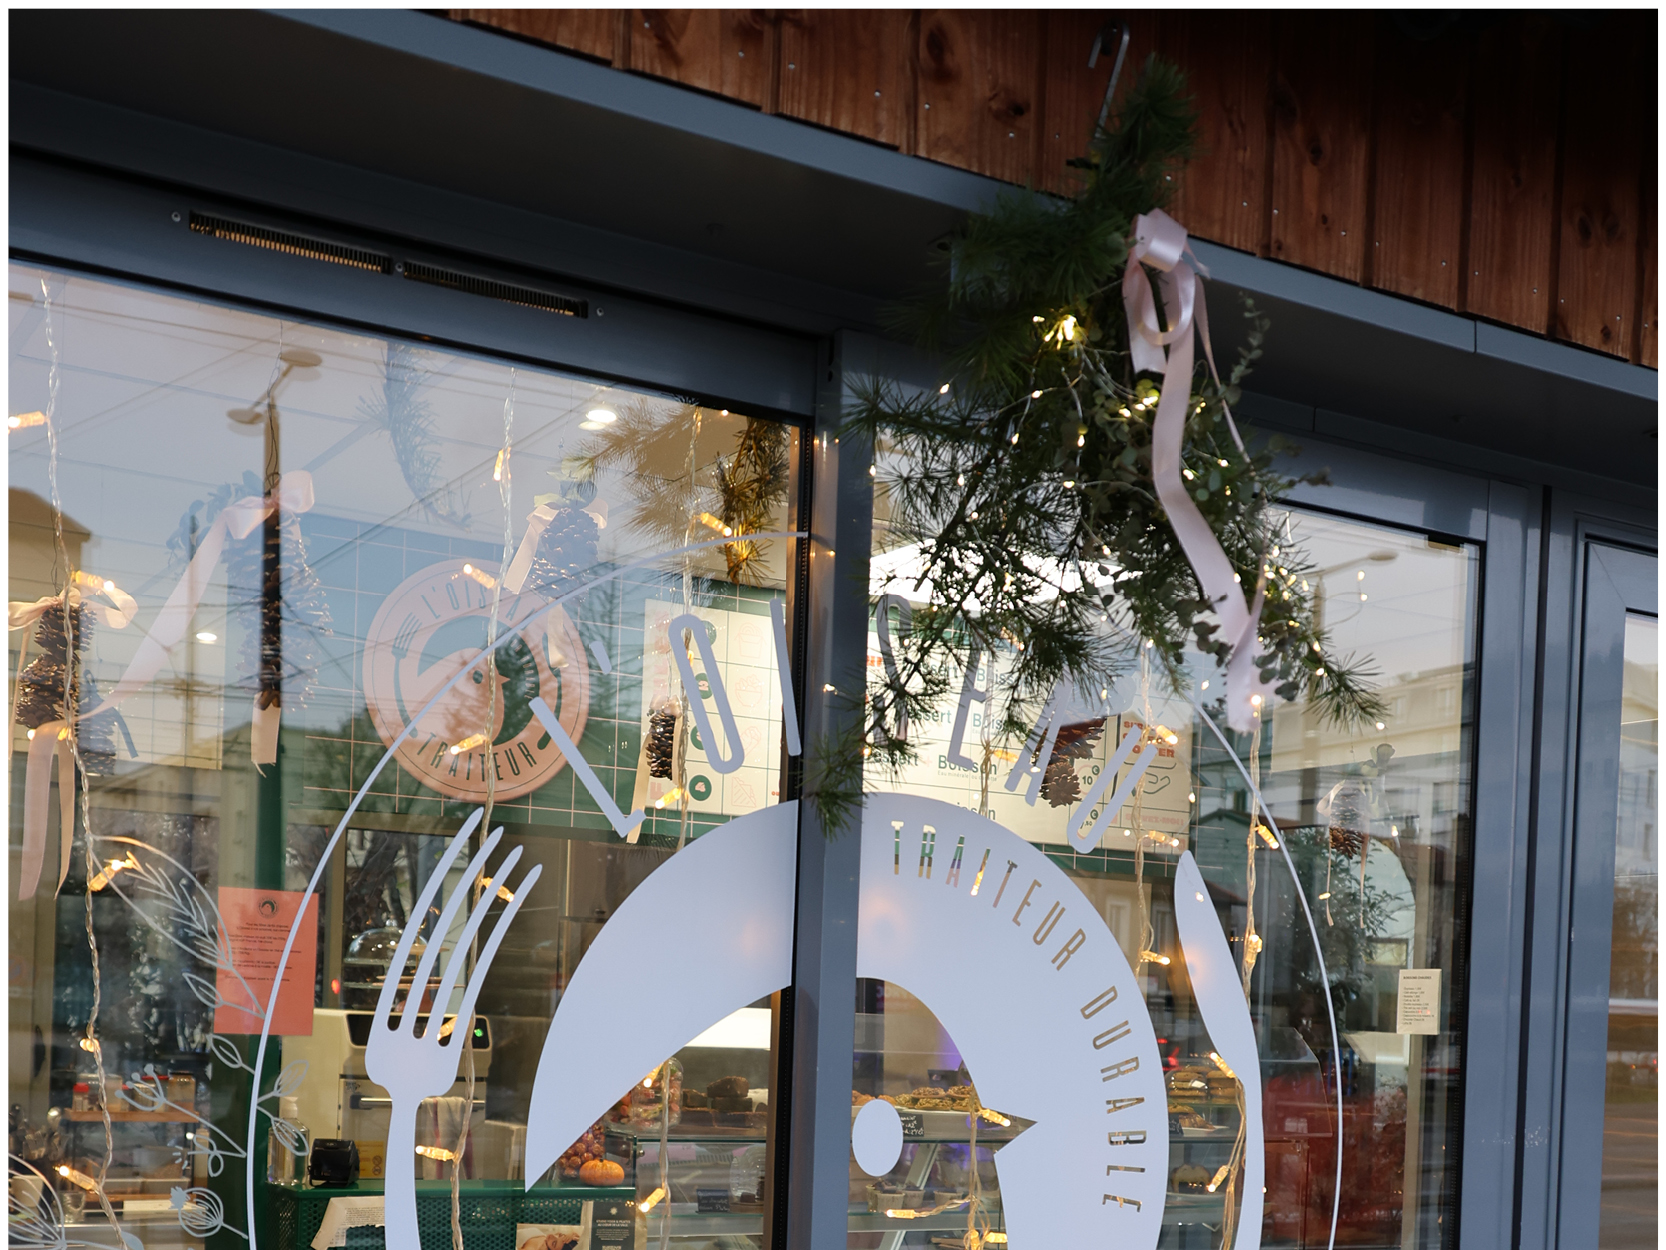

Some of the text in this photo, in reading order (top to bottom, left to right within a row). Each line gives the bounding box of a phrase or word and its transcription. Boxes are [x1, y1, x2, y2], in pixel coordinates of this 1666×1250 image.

[421, 580, 535, 631] L'OISA
[908, 709, 952, 724] essert
[416, 731, 537, 782] TRAITEUR
[1082, 776, 1093, 785] 10
[891, 820, 1147, 1213] TRAITEUR DURABLE
